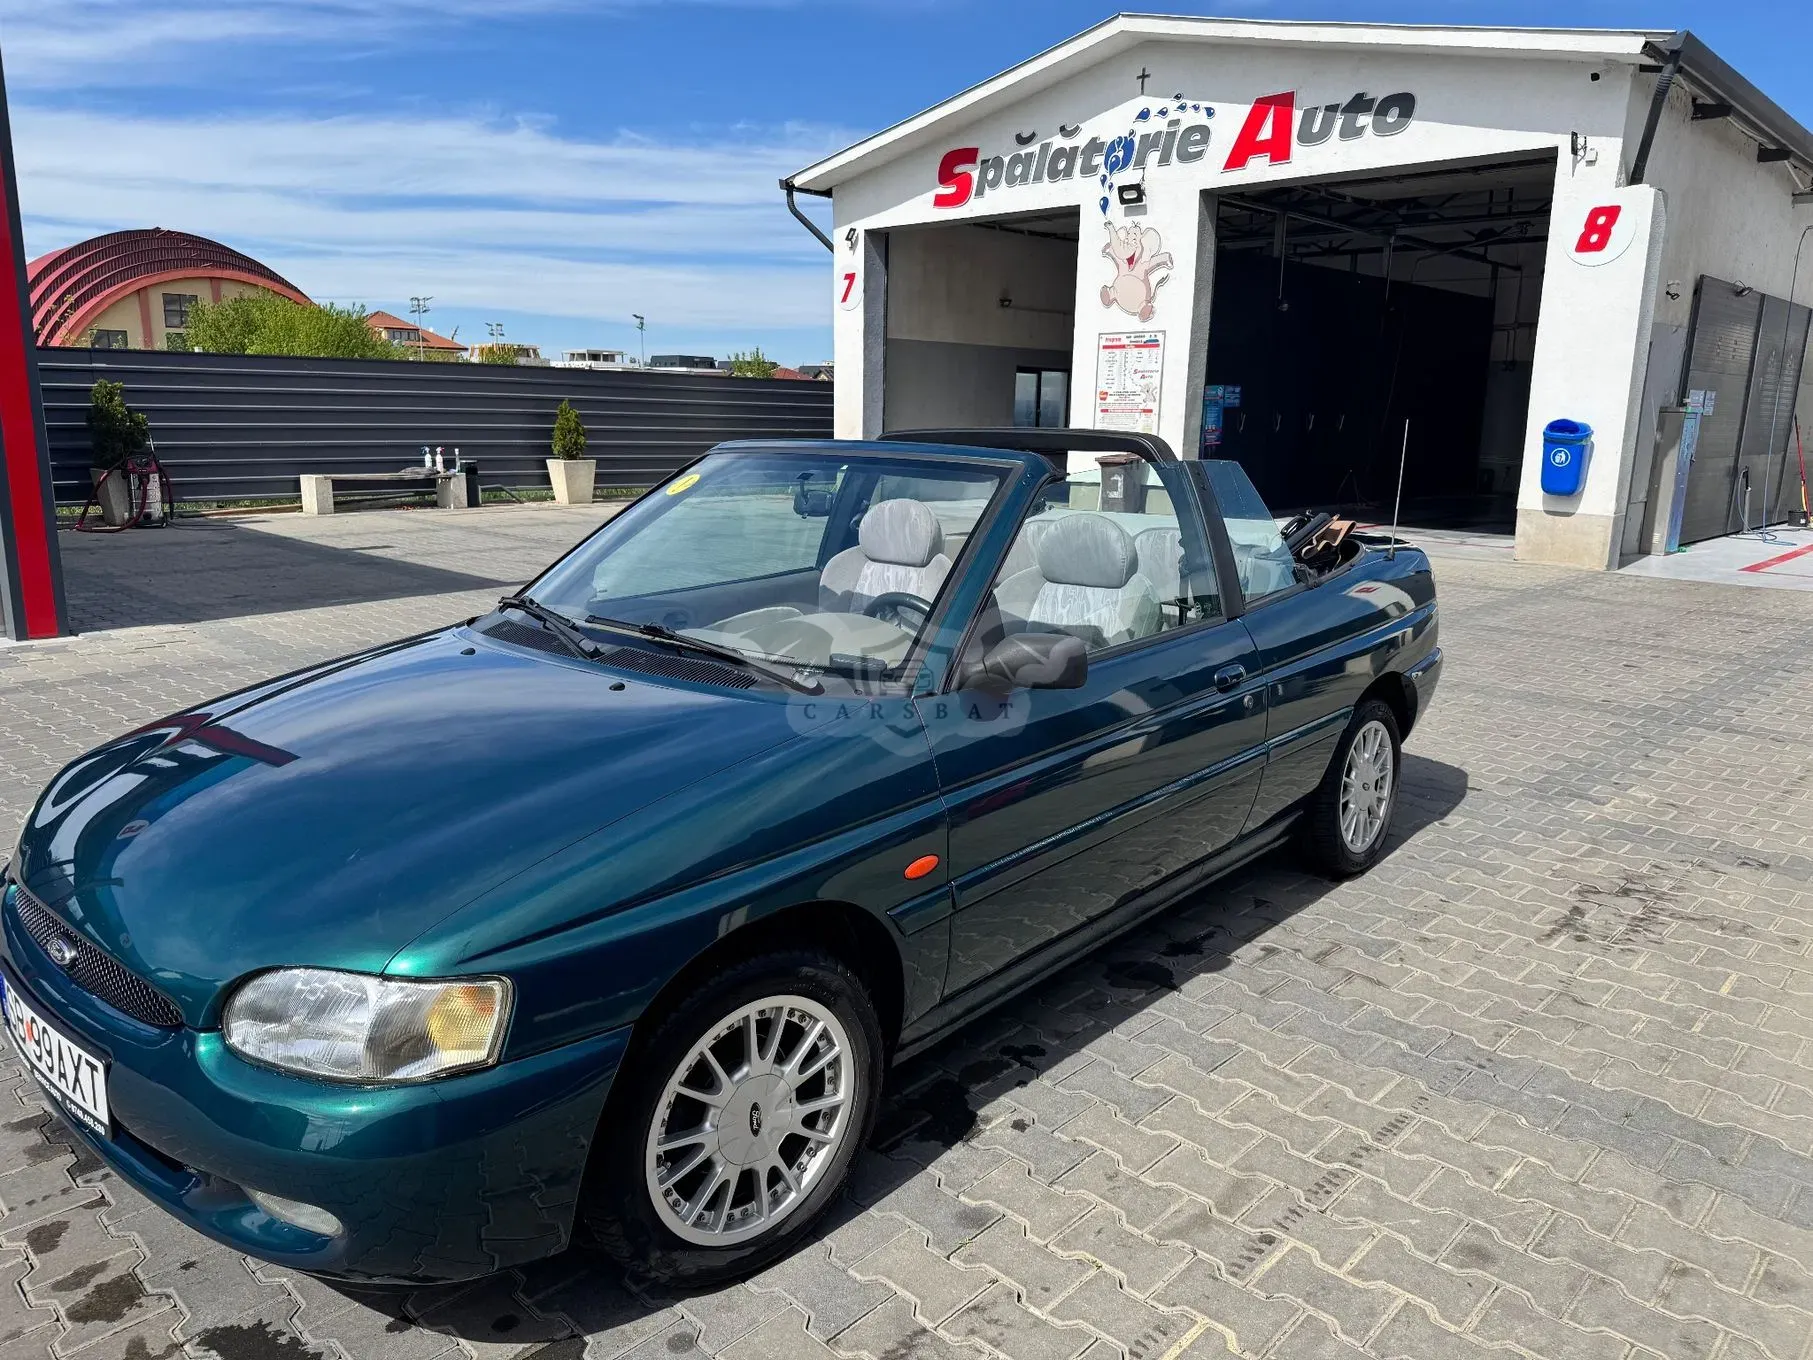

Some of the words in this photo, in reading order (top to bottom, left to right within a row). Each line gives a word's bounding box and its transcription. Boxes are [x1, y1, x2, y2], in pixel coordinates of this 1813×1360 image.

[1221, 90, 1416, 173] Auto
[1575, 205, 1621, 253] 8
[840, 272, 856, 303] 7
